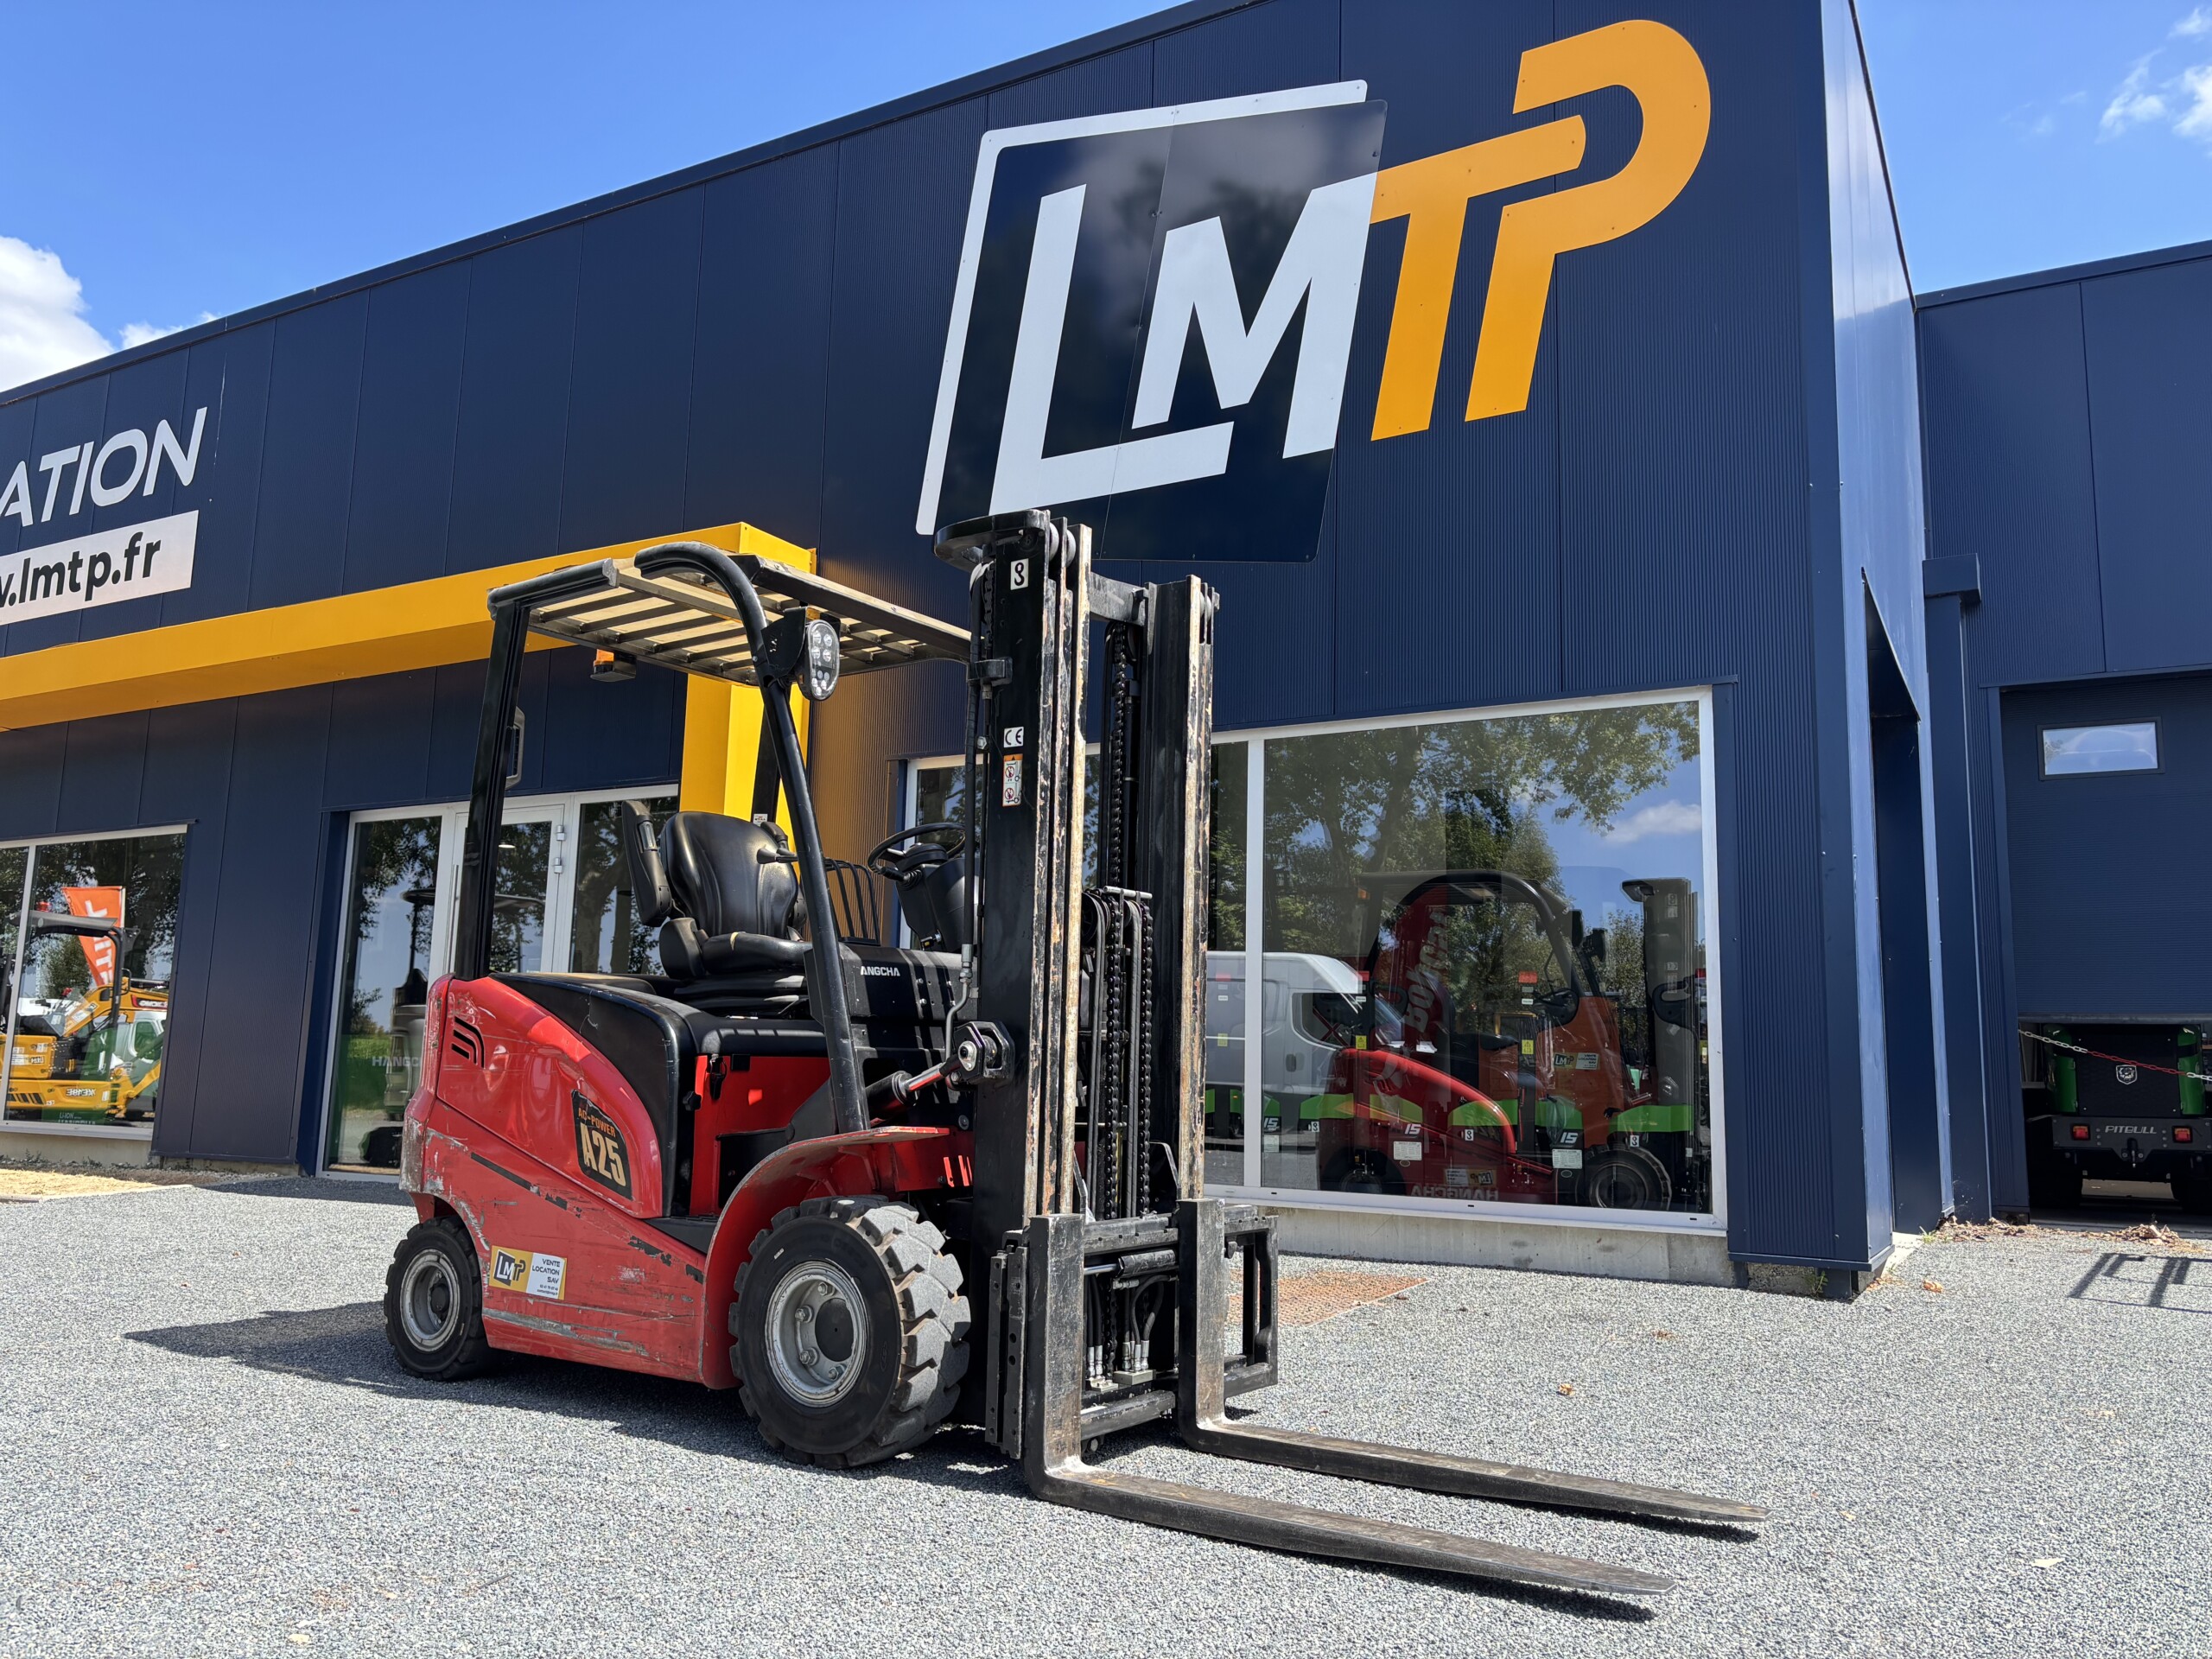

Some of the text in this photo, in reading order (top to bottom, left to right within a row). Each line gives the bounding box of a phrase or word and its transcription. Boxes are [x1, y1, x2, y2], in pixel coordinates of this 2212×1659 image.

[988, 19, 1712, 515] LMTP
[0, 407, 207, 527] ATION
[861, 966, 900, 976] ANGCHA
[372, 1056, 422, 1066] HANGC
[578, 1108, 616, 1138] AC-POWER
[2105, 1125, 2158, 1135] PITBULL
[580, 1122, 626, 1187] A25
[496, 1255, 526, 1281] LMTP
[542, 1258, 561, 1268] VENTE
[532, 1265, 560, 1276] LOCATION
[547, 1276, 559, 1285] SAV
